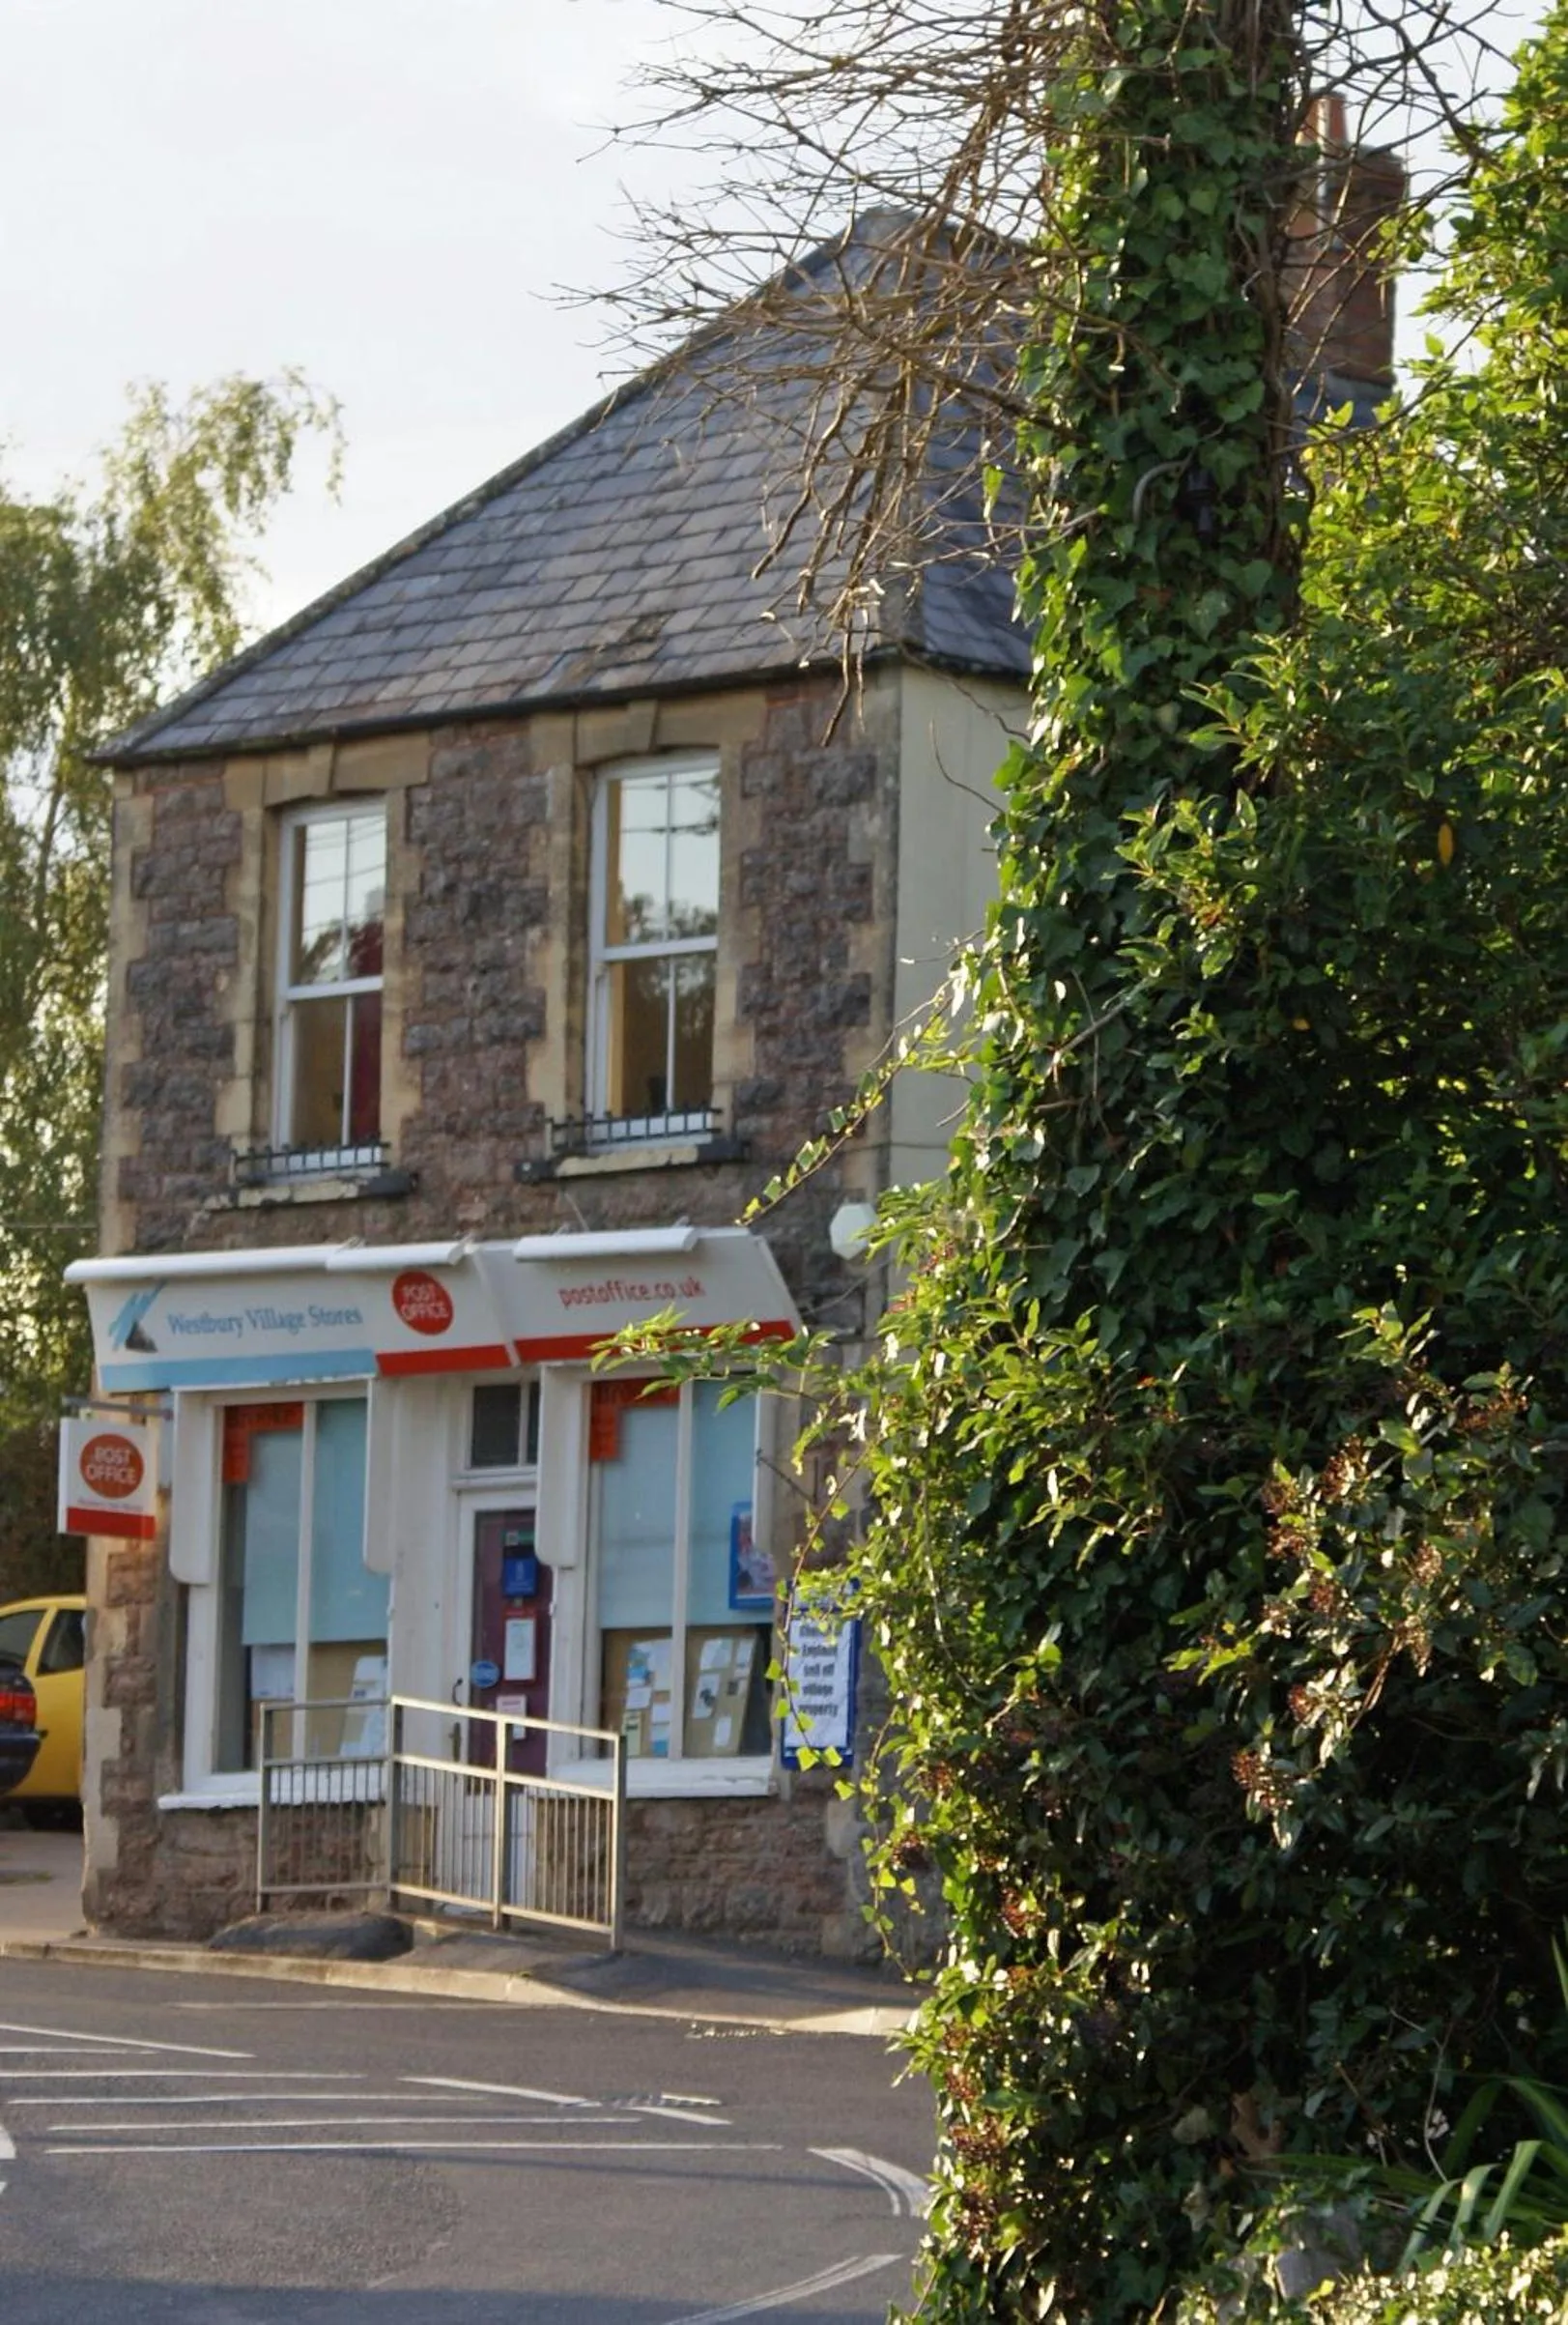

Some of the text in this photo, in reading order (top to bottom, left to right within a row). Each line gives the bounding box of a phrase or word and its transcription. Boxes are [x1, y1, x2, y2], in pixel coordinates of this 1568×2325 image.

[403, 1283, 435, 1303] POST
[558, 1276, 706, 1310] postoffice.co.uk
[400, 1302, 449, 1321] OFFICE
[167, 1306, 363, 1338] Westbury Village Stores
[95, 1447, 131, 1464] POST
[85, 1464, 137, 1485] OFFICE
